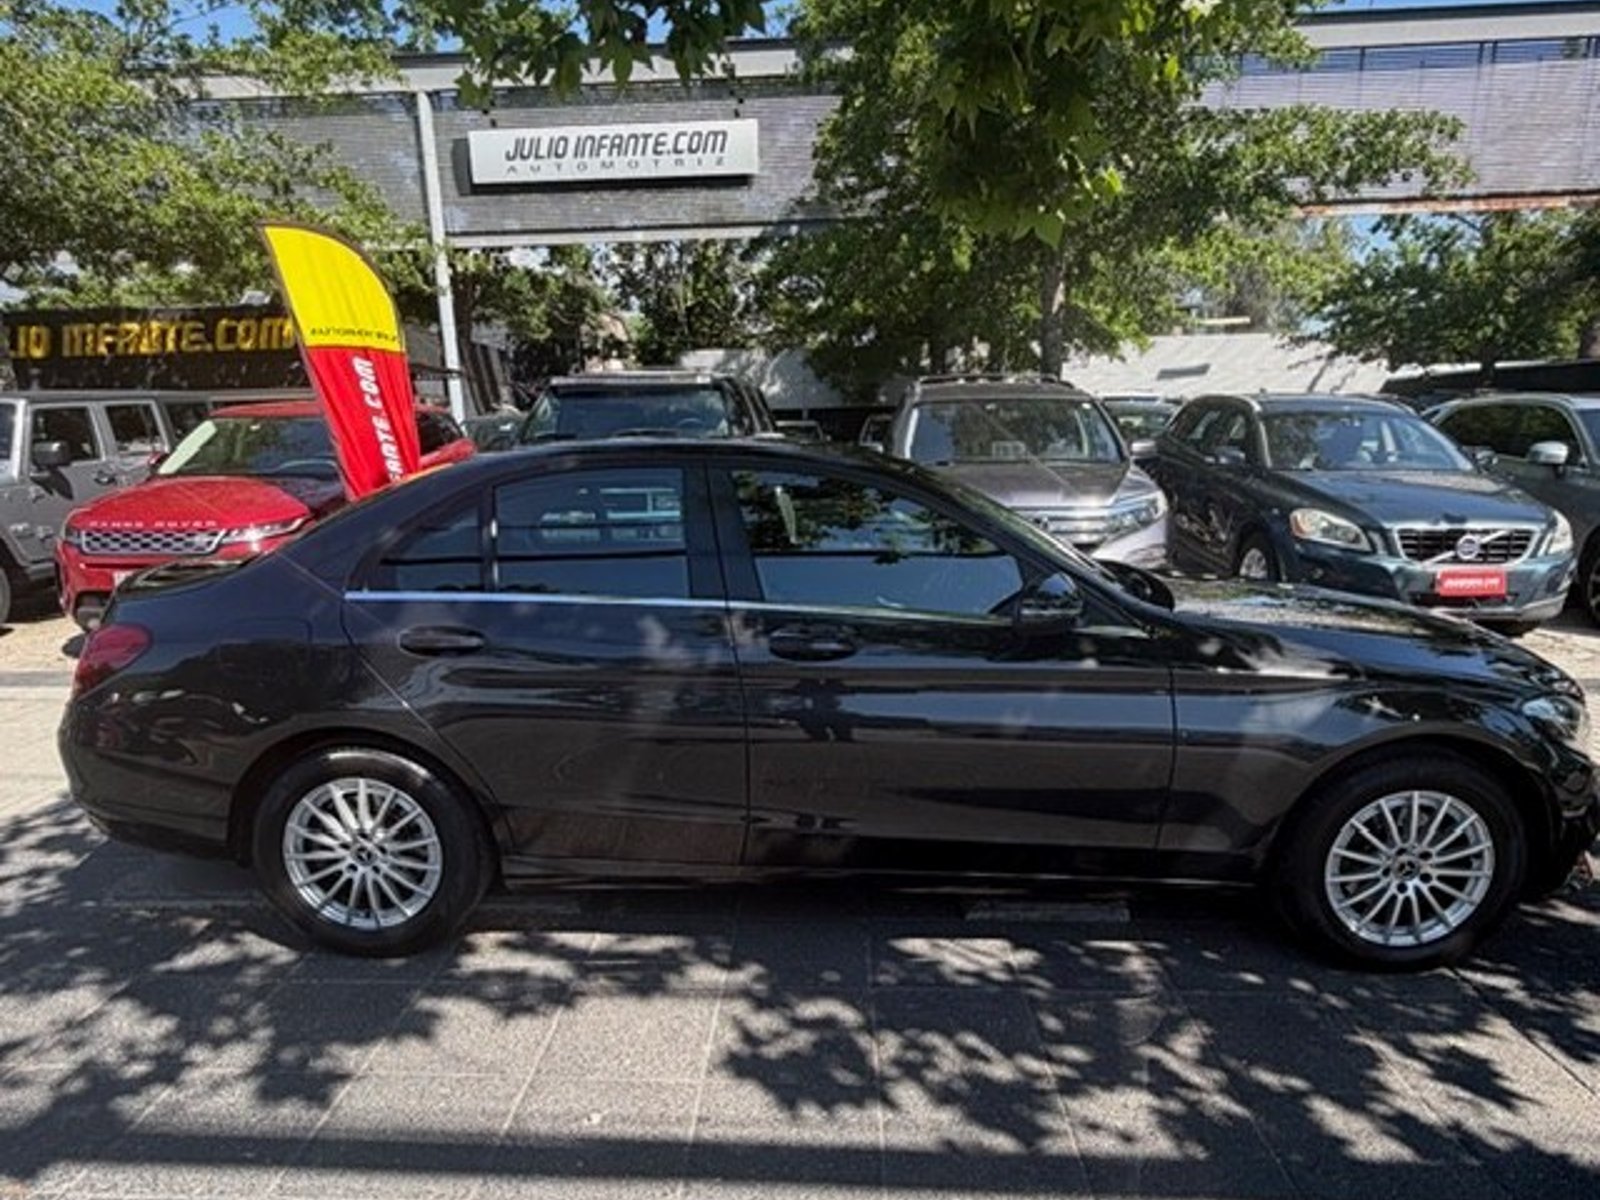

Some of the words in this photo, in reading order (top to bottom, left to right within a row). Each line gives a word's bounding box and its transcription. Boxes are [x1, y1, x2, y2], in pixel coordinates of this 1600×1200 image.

[505, 135, 569, 162] JULIO
[573, 130, 728, 158] INFANTE.COM
[506, 157, 725, 173] AUTOMOTRIZ
[9, 325, 49, 358] IO
